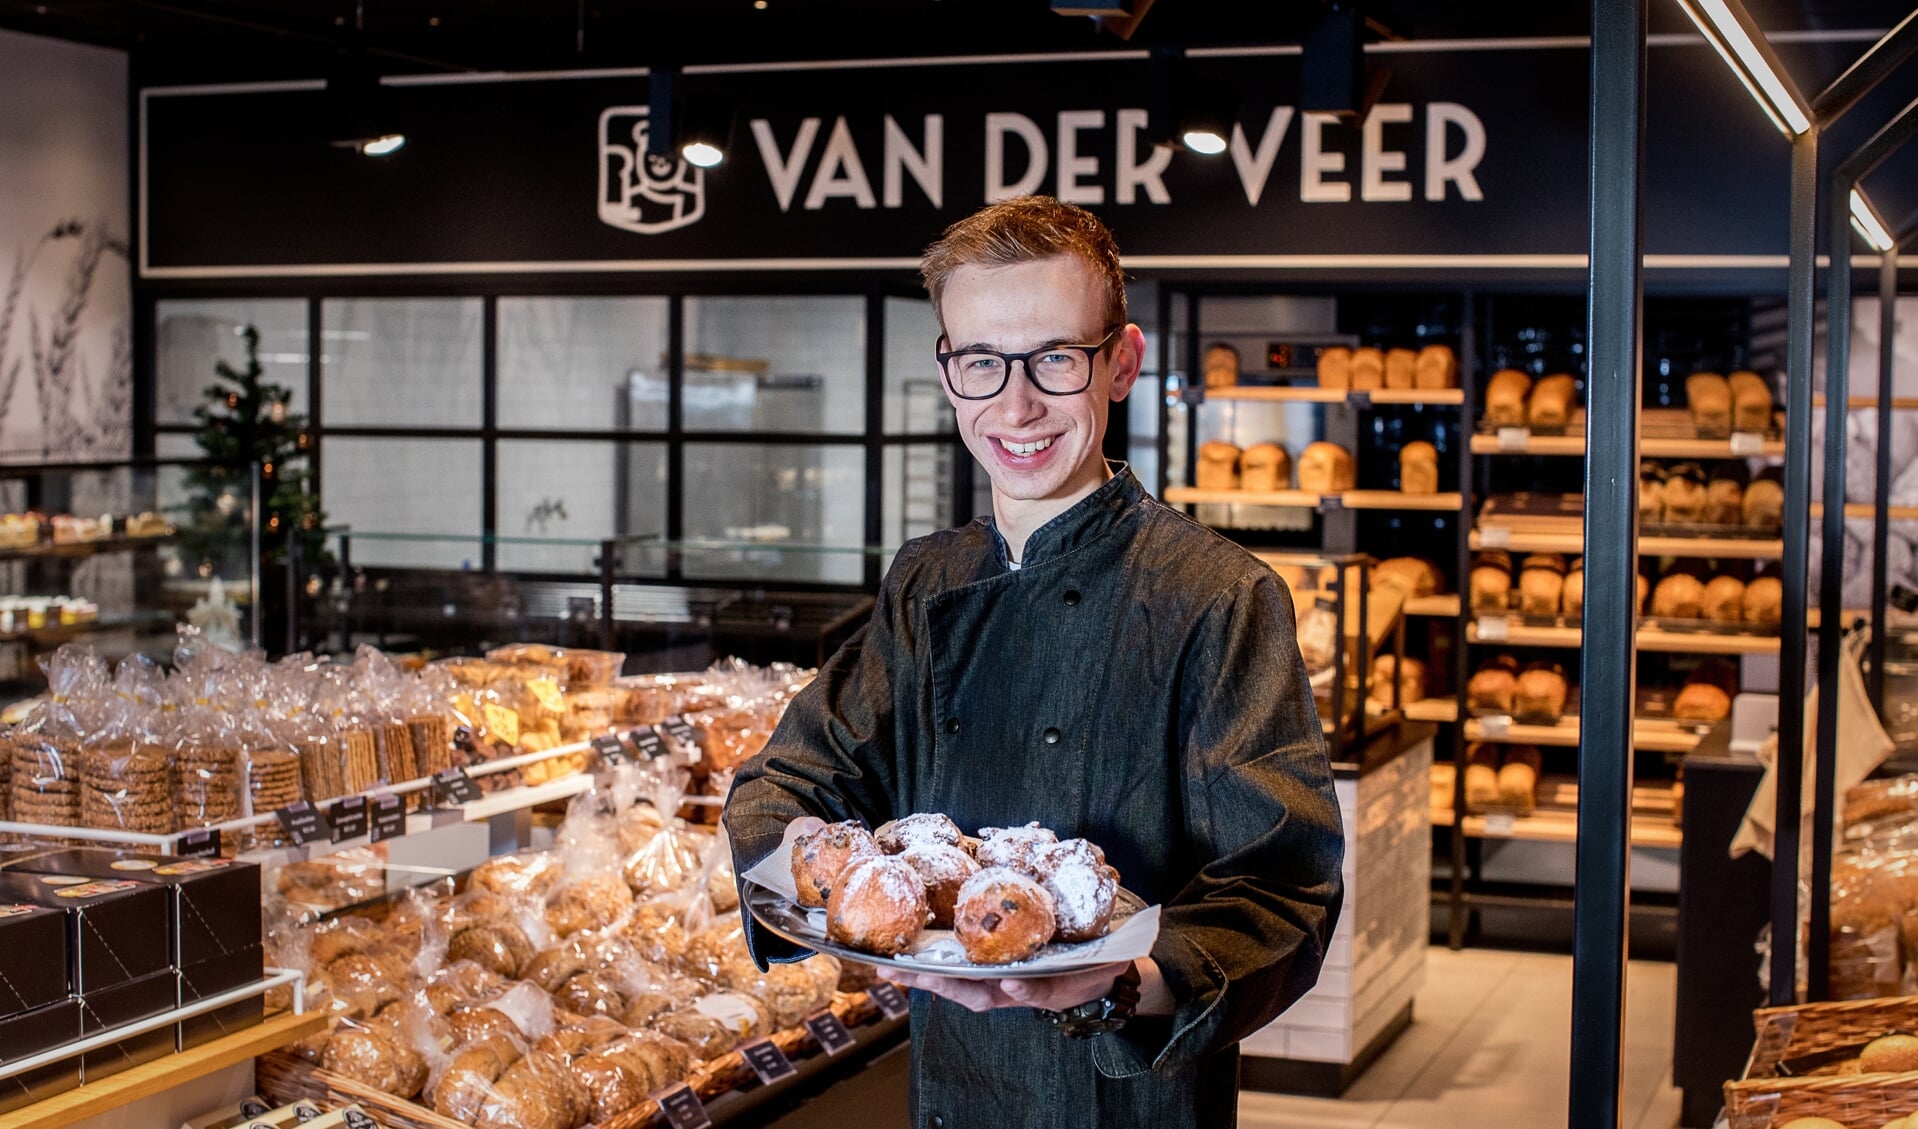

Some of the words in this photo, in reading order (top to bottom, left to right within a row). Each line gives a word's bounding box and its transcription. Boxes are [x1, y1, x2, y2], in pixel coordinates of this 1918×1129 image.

[750, 114, 943, 213] VAN
[985, 109, 1173, 205] DER
[1230, 102, 1486, 206] VEER
